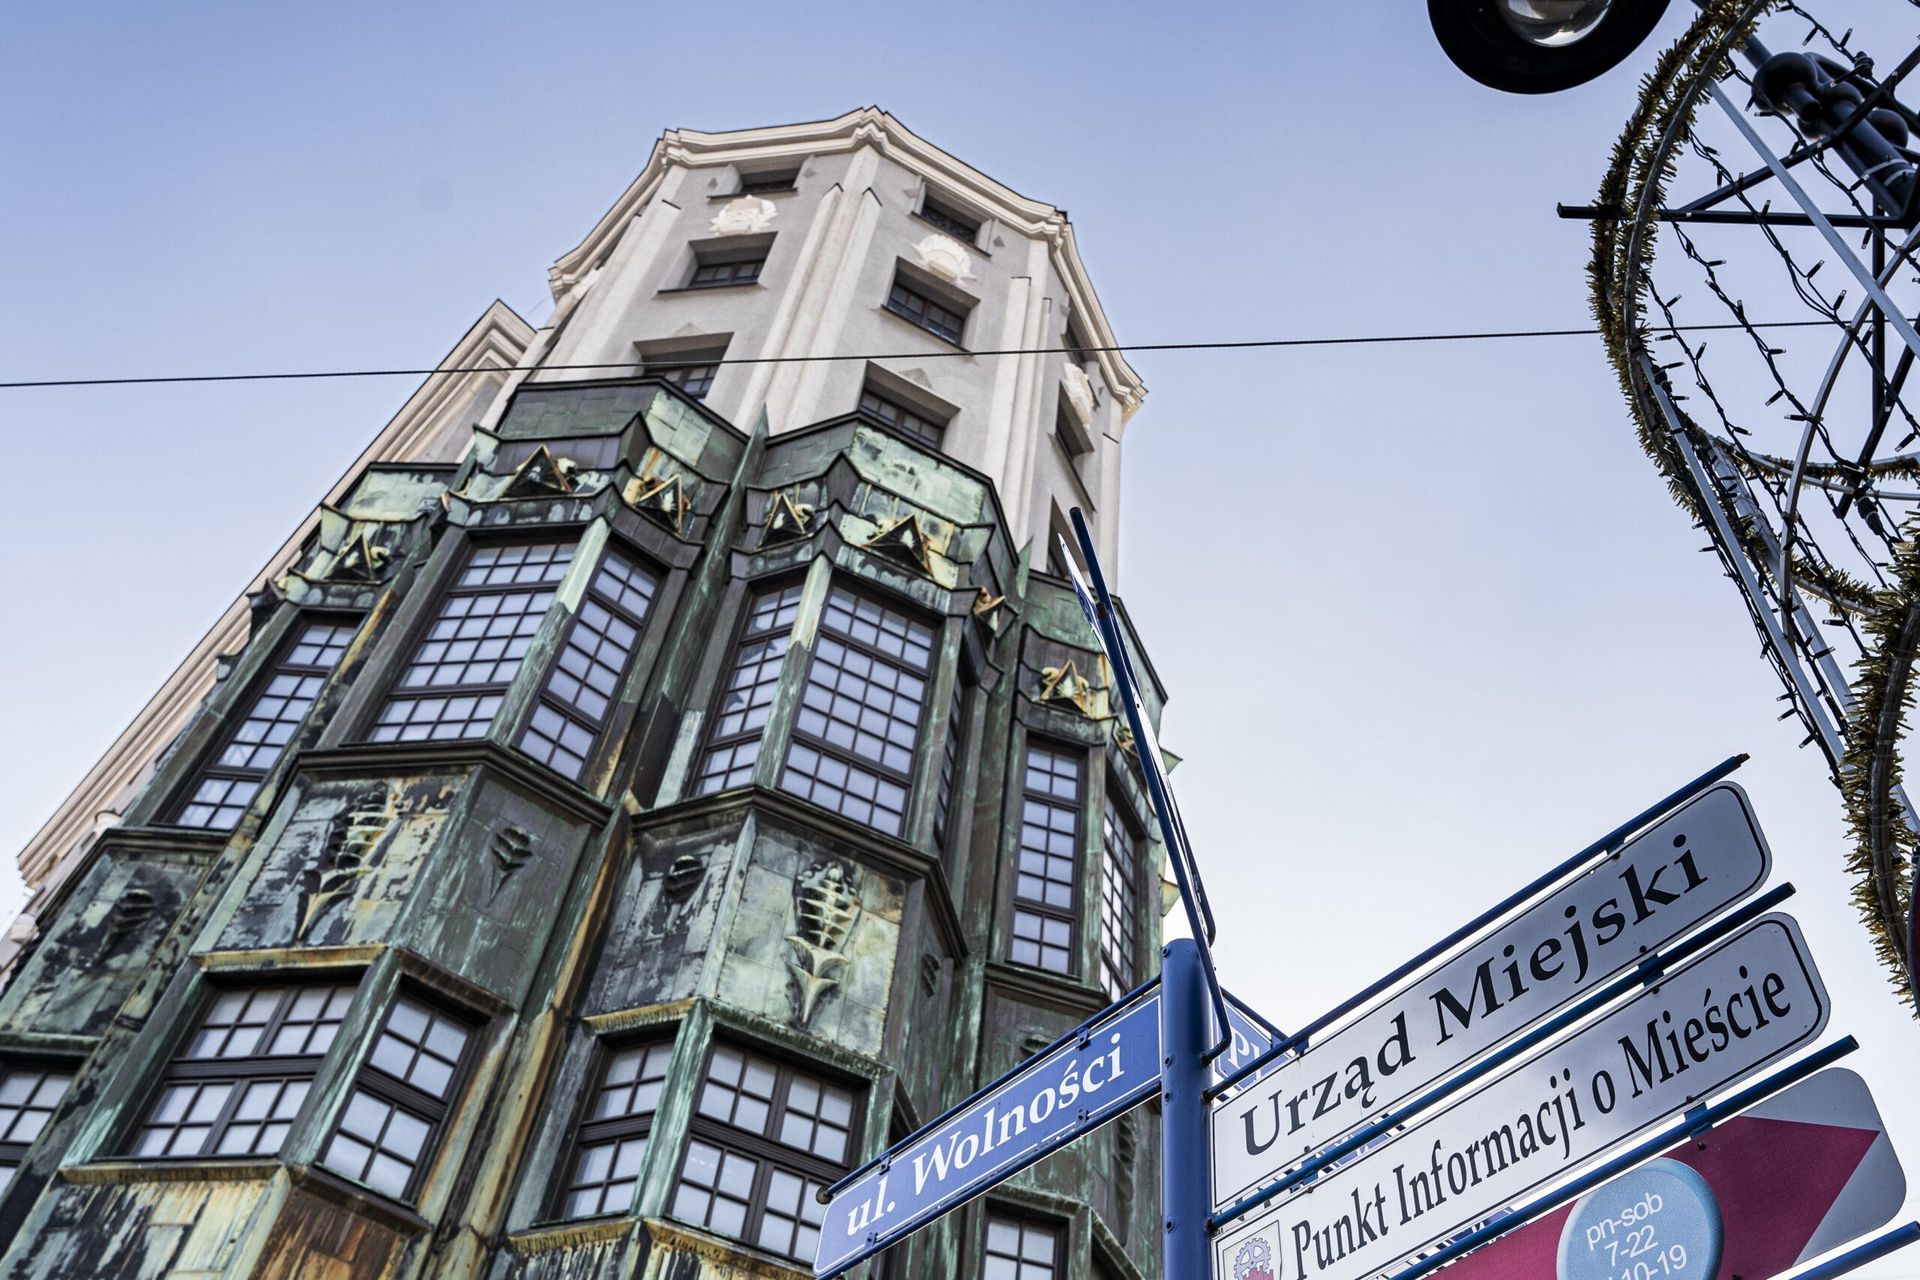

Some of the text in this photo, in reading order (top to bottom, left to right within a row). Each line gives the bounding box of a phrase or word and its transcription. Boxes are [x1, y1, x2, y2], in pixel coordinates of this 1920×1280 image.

[1240, 833, 1709, 1156] Urząd Miejski
[847, 1033, 1125, 1237] ul. Wolności
[1291, 965, 1792, 1280] Punkt Informacji o Mieście
[1586, 1192, 1663, 1252] pn-sob
[1604, 1224, 1659, 1267] 7-22
